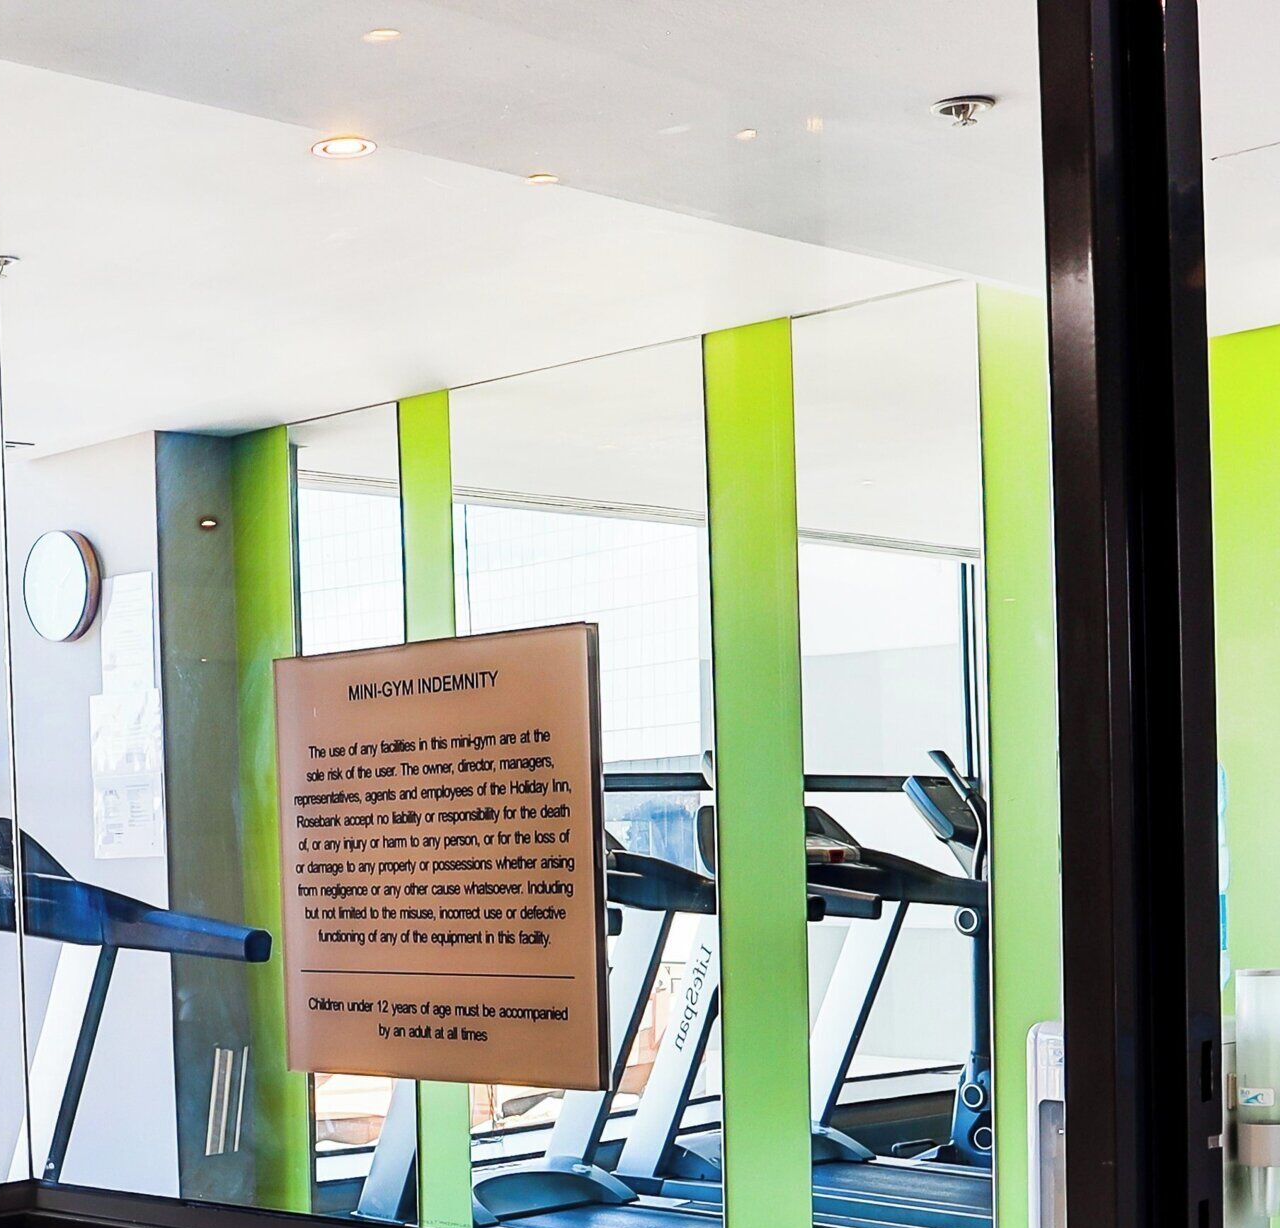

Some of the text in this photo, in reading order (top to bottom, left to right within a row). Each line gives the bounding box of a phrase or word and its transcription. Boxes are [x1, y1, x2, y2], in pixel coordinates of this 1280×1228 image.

[348, 670, 499, 702] MINI-GYM INDEMNITY
[308, 728, 551, 759] The use of any facilities in this mini-gym are at the
[306, 756, 554, 783] sole risk of the user. The owner, director, managers,
[293, 778, 572, 809] representatives, agents and employees of the Holiday Inn,
[296, 803, 570, 829] Rosebank accept no liability or responsibility for the death
[298, 828, 571, 854] of, or any injury or harm to any person, or for the loss of
[295, 854, 575, 877] or damage to any property or possessions whether arising
[297, 880, 574, 900] from negligence or any other cause whatsoever. Including
[304, 905, 566, 921] but not limited to the misuse, incorrect use or defective
[318, 928, 551, 949] functioning of any of the equipment in this facility.
[308, 996, 568, 1023] Children under 12 years of age must be accompanied
[378, 1023, 488, 1042] by an adult at all times
